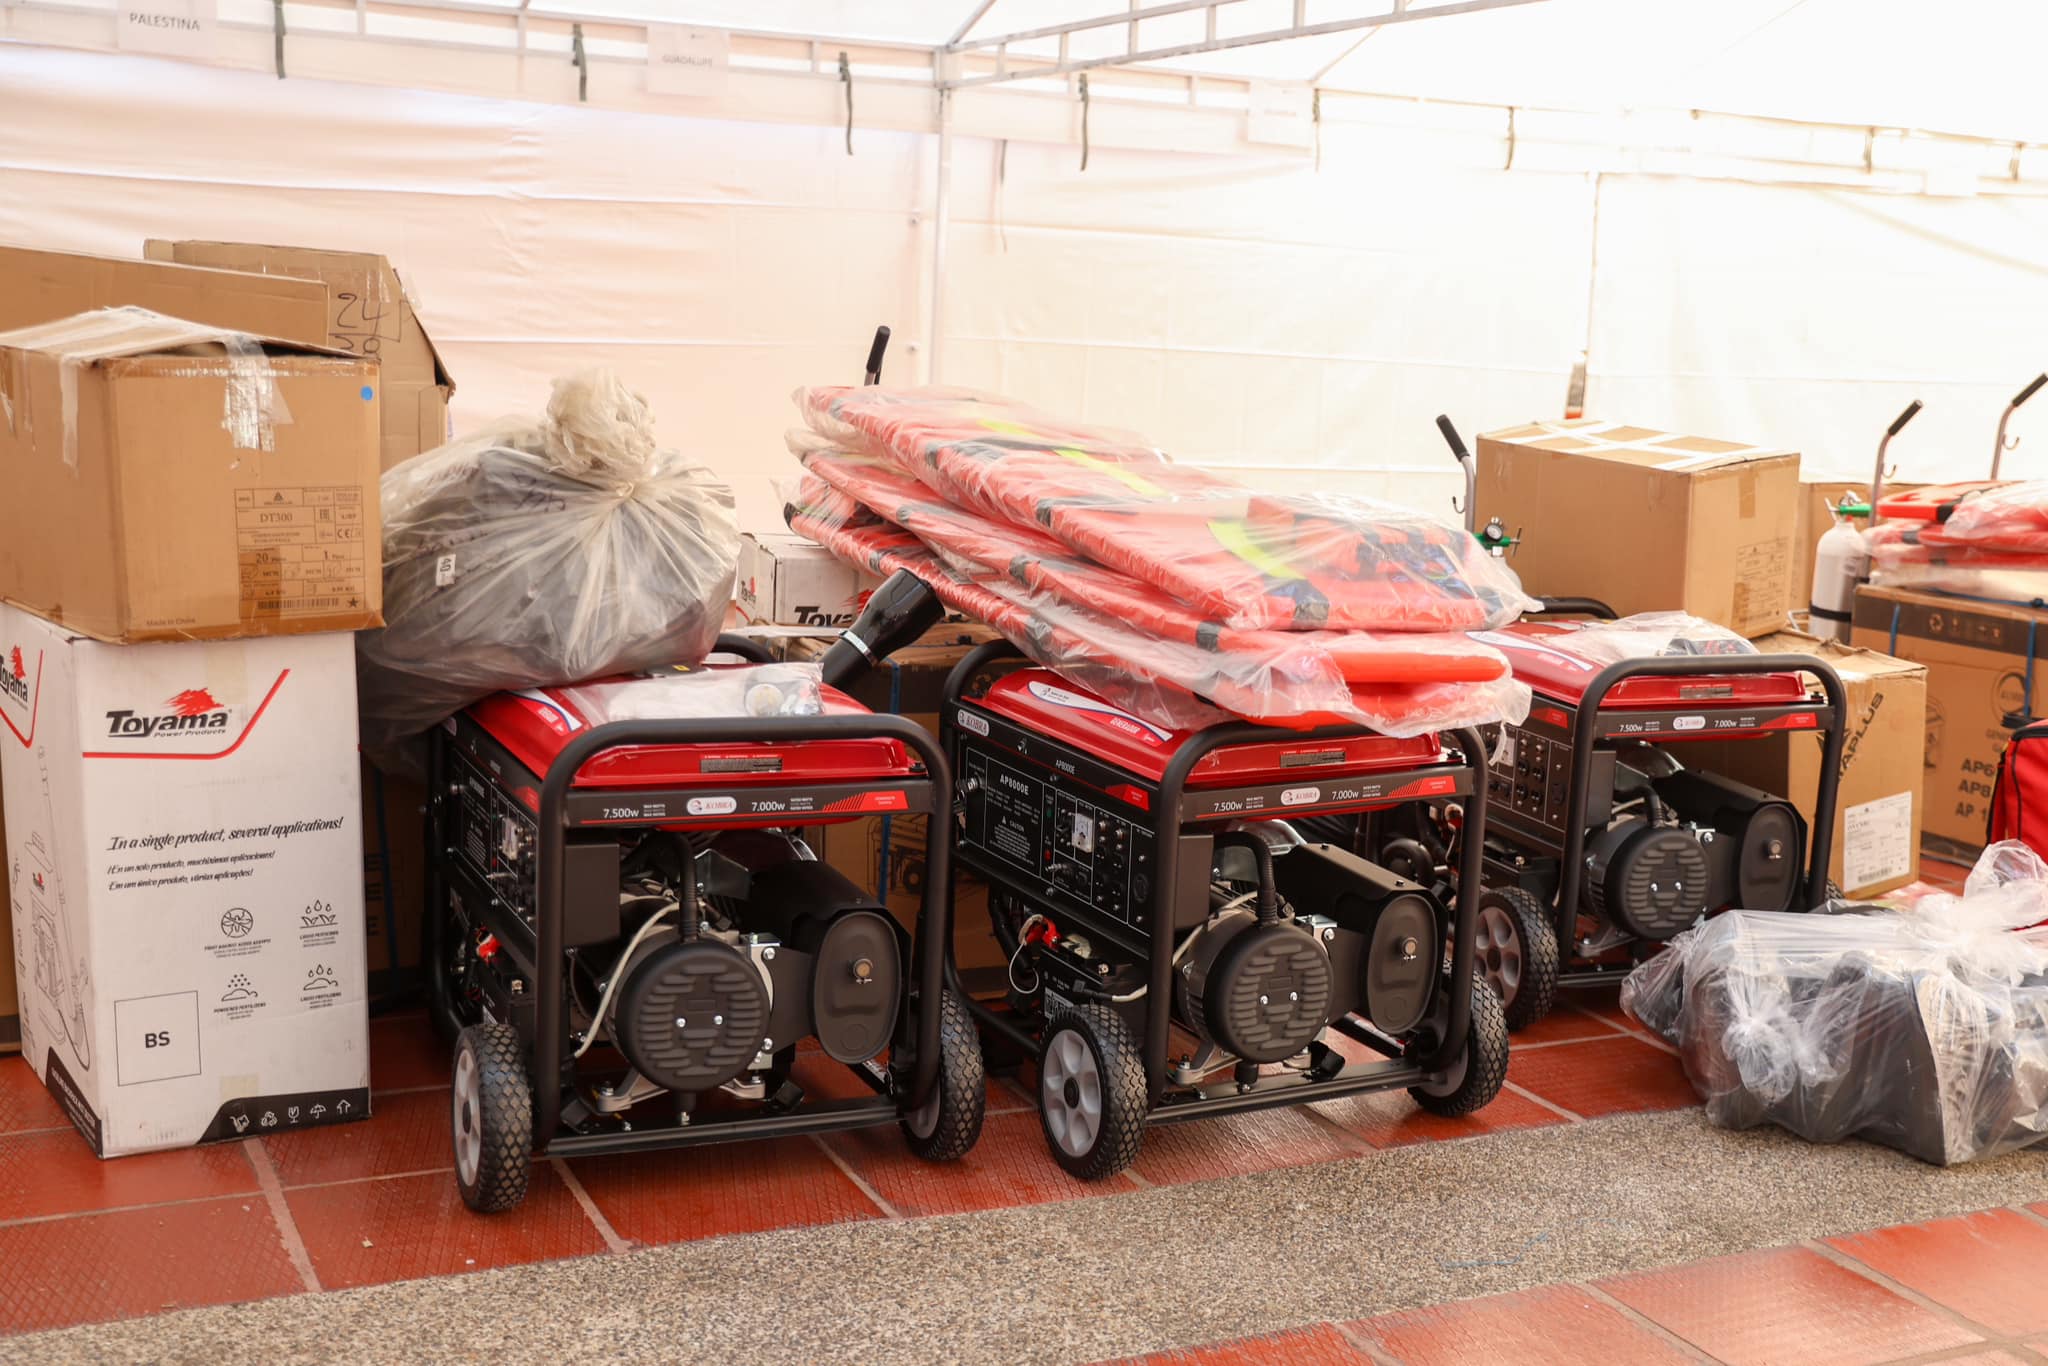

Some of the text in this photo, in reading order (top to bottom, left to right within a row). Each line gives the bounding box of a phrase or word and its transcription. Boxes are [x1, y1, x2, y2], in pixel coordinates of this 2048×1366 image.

[129, 12, 200, 32] PALESTINA
[260, 512, 293, 523] DT300
[256, 552, 268, 564] 20
[794, 606, 853, 627] Toya
[106, 710, 230, 737] Toyama
[153, 728, 227, 738] Power Products
[1618, 723, 1643, 733] 7.500w
[1713, 718, 1738, 728] 7.000w
[1839, 692, 1884, 780] APLUS
[1961, 758, 1995, 777] AP6
[999, 774, 1029, 796] AP8000E
[1958, 779, 1992, 798] AP8
[603, 807, 640, 819] 7.500w
[752, 800, 786, 812] 7.000w
[1213, 802, 1243, 812] 7.500w
[1332, 790, 1359, 801] 7.000w
[106, 816, 344, 851] In a single product, several applications!
[144, 1030, 171, 1049] BS
